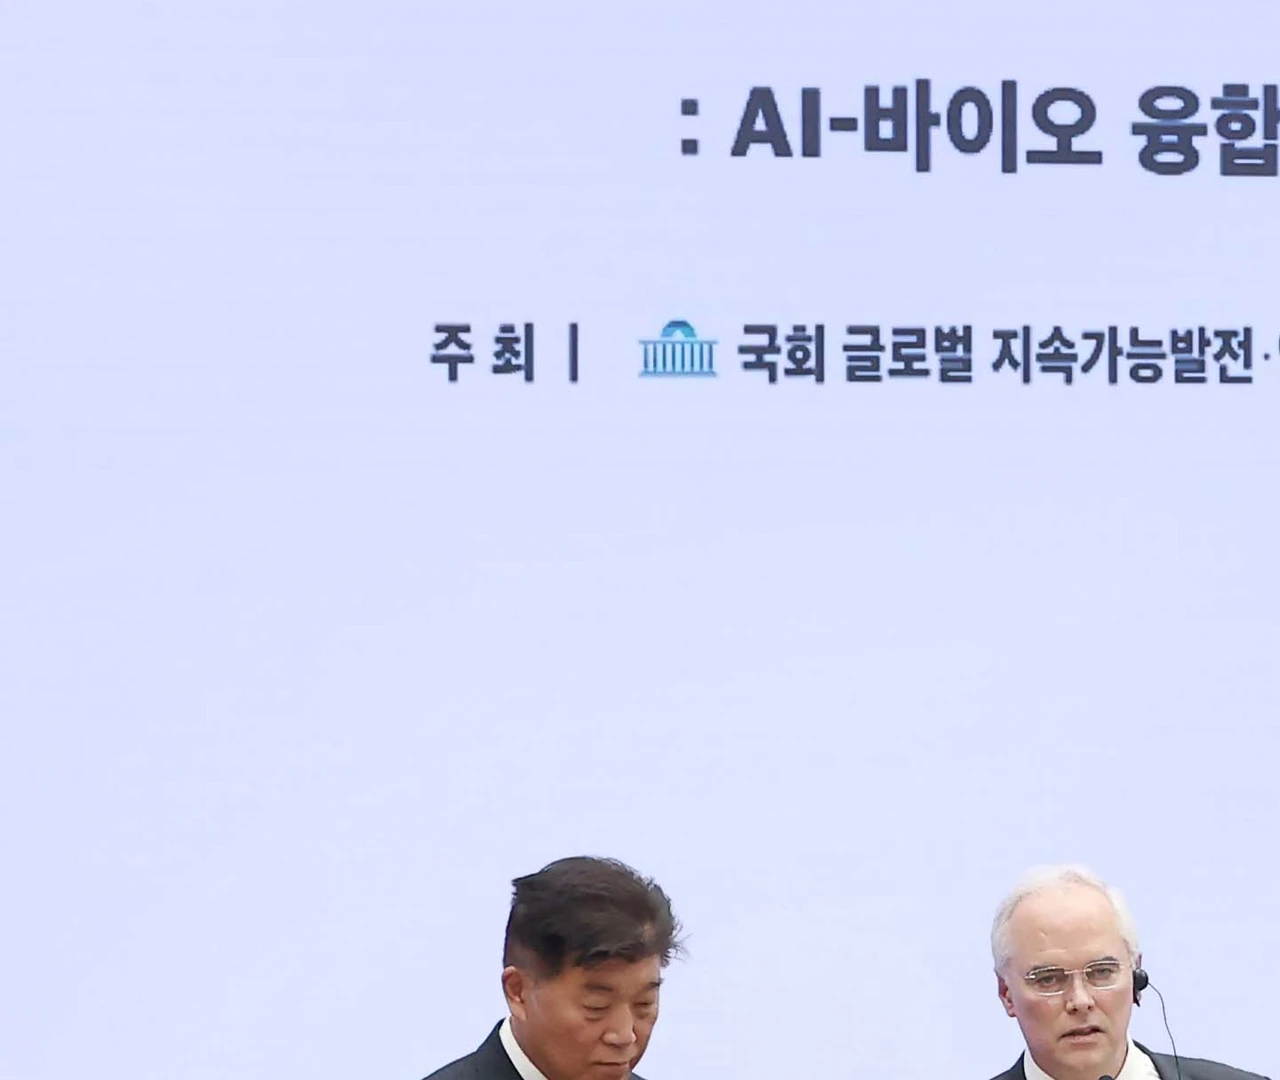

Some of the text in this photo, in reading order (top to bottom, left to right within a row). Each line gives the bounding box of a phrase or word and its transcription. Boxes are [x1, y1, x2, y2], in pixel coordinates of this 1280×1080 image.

[730, 78, 1103, 174] AI-바이오
[737, 324, 825, 385] 국회
[842, 325, 972, 383] 글로벌
